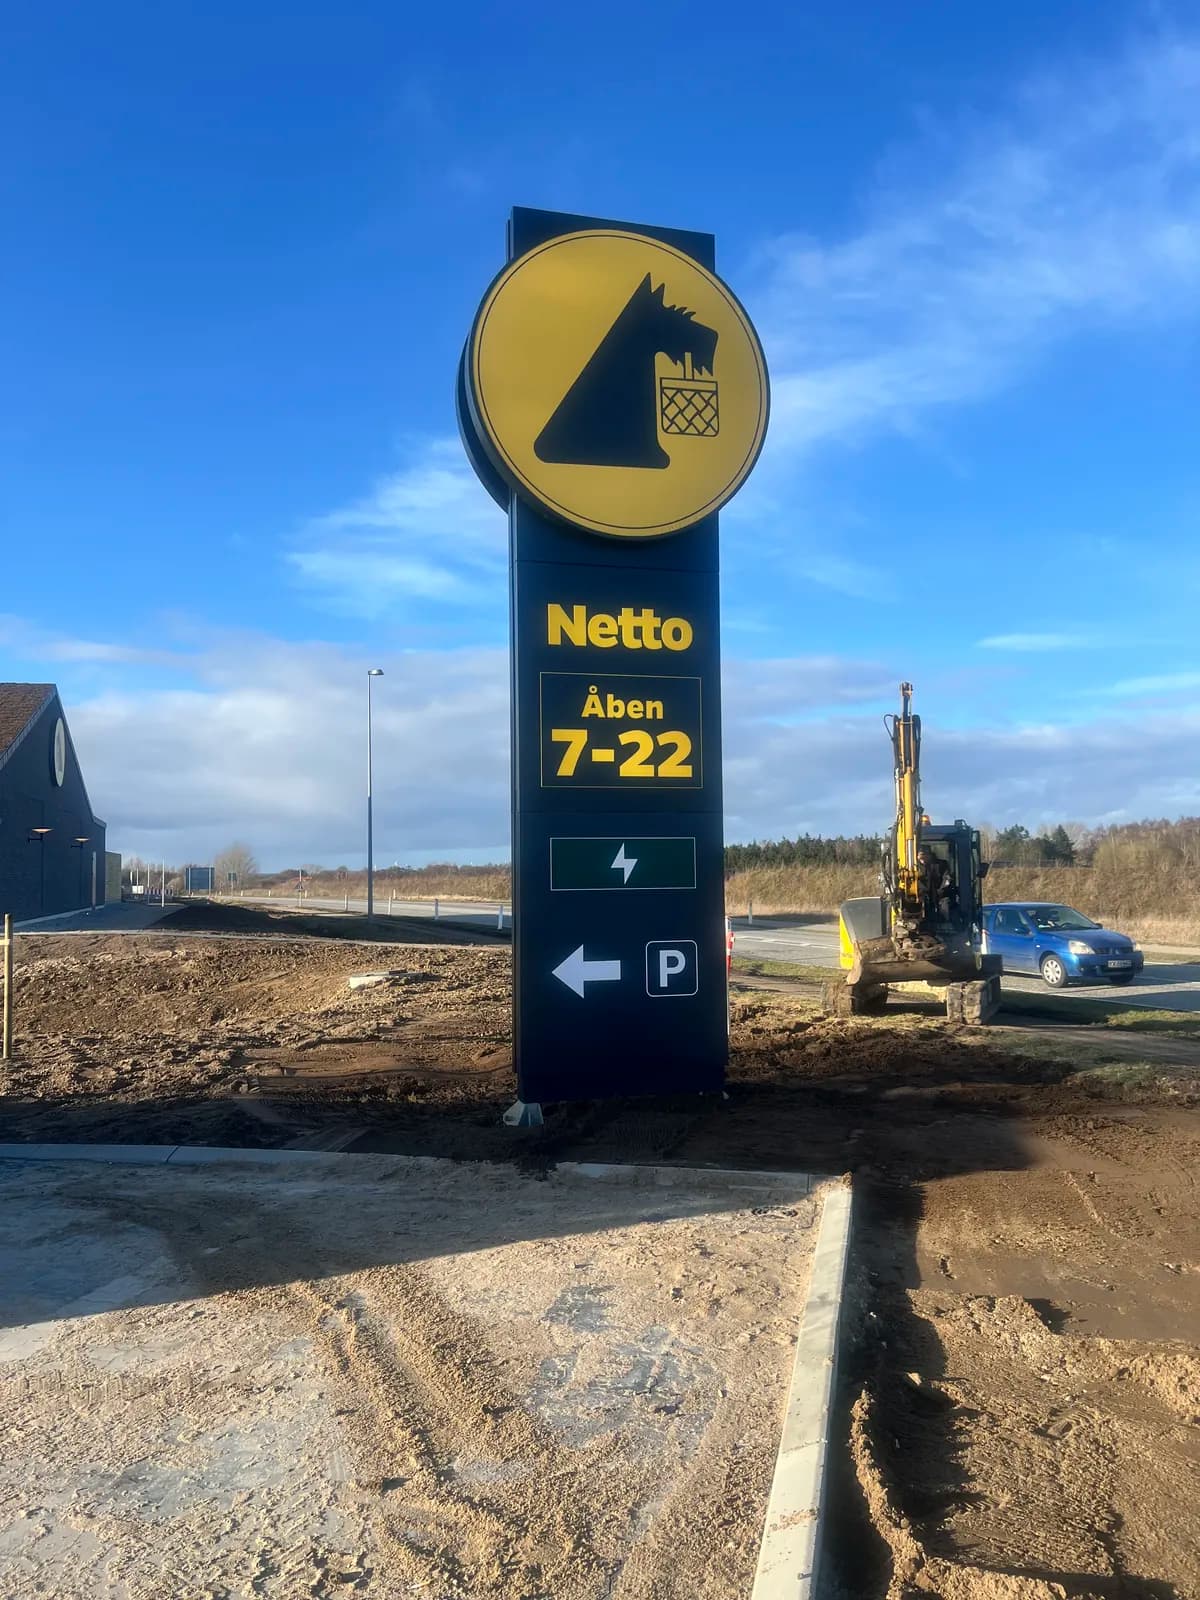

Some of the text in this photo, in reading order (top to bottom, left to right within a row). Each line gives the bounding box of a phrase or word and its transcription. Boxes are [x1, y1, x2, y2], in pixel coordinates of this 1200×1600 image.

[547, 603, 693, 651] Netto
[582, 685, 664, 719] Åben
[551, 729, 693, 777] 7-22
[659, 949, 686, 987] P
